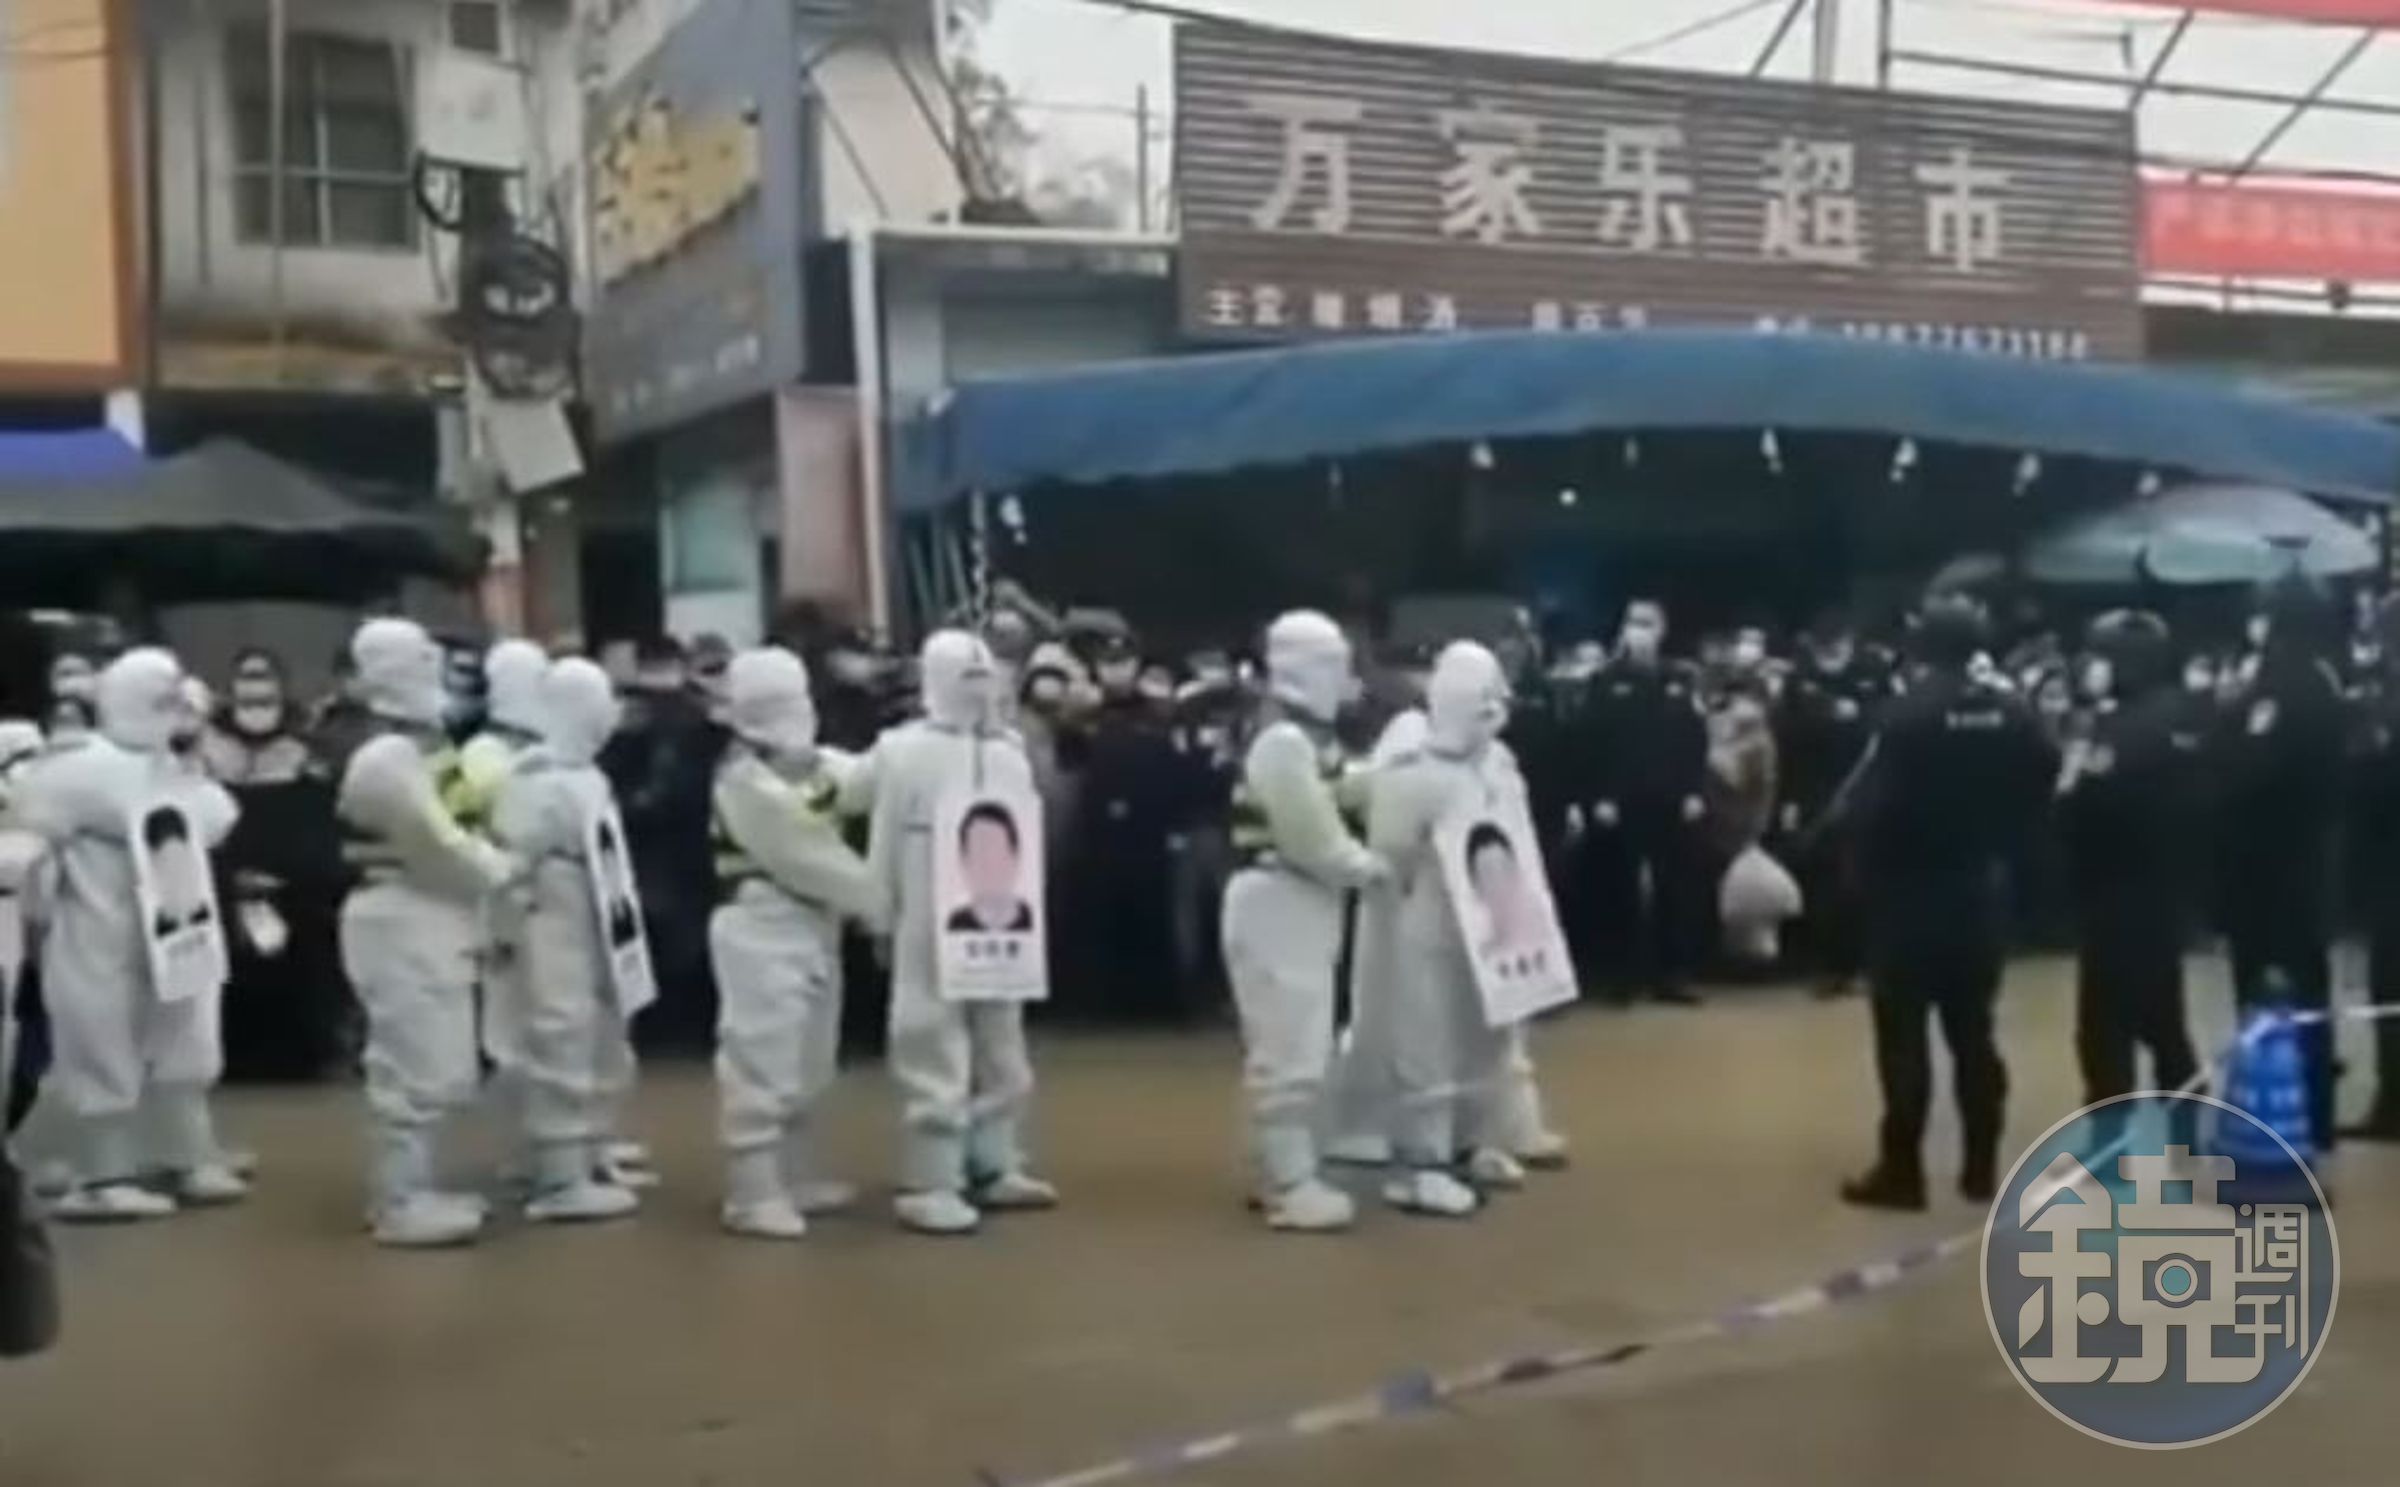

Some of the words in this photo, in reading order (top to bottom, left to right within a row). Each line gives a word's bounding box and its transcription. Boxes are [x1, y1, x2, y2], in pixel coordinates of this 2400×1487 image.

[1240, 94, 2016, 274] 万家乐超市
